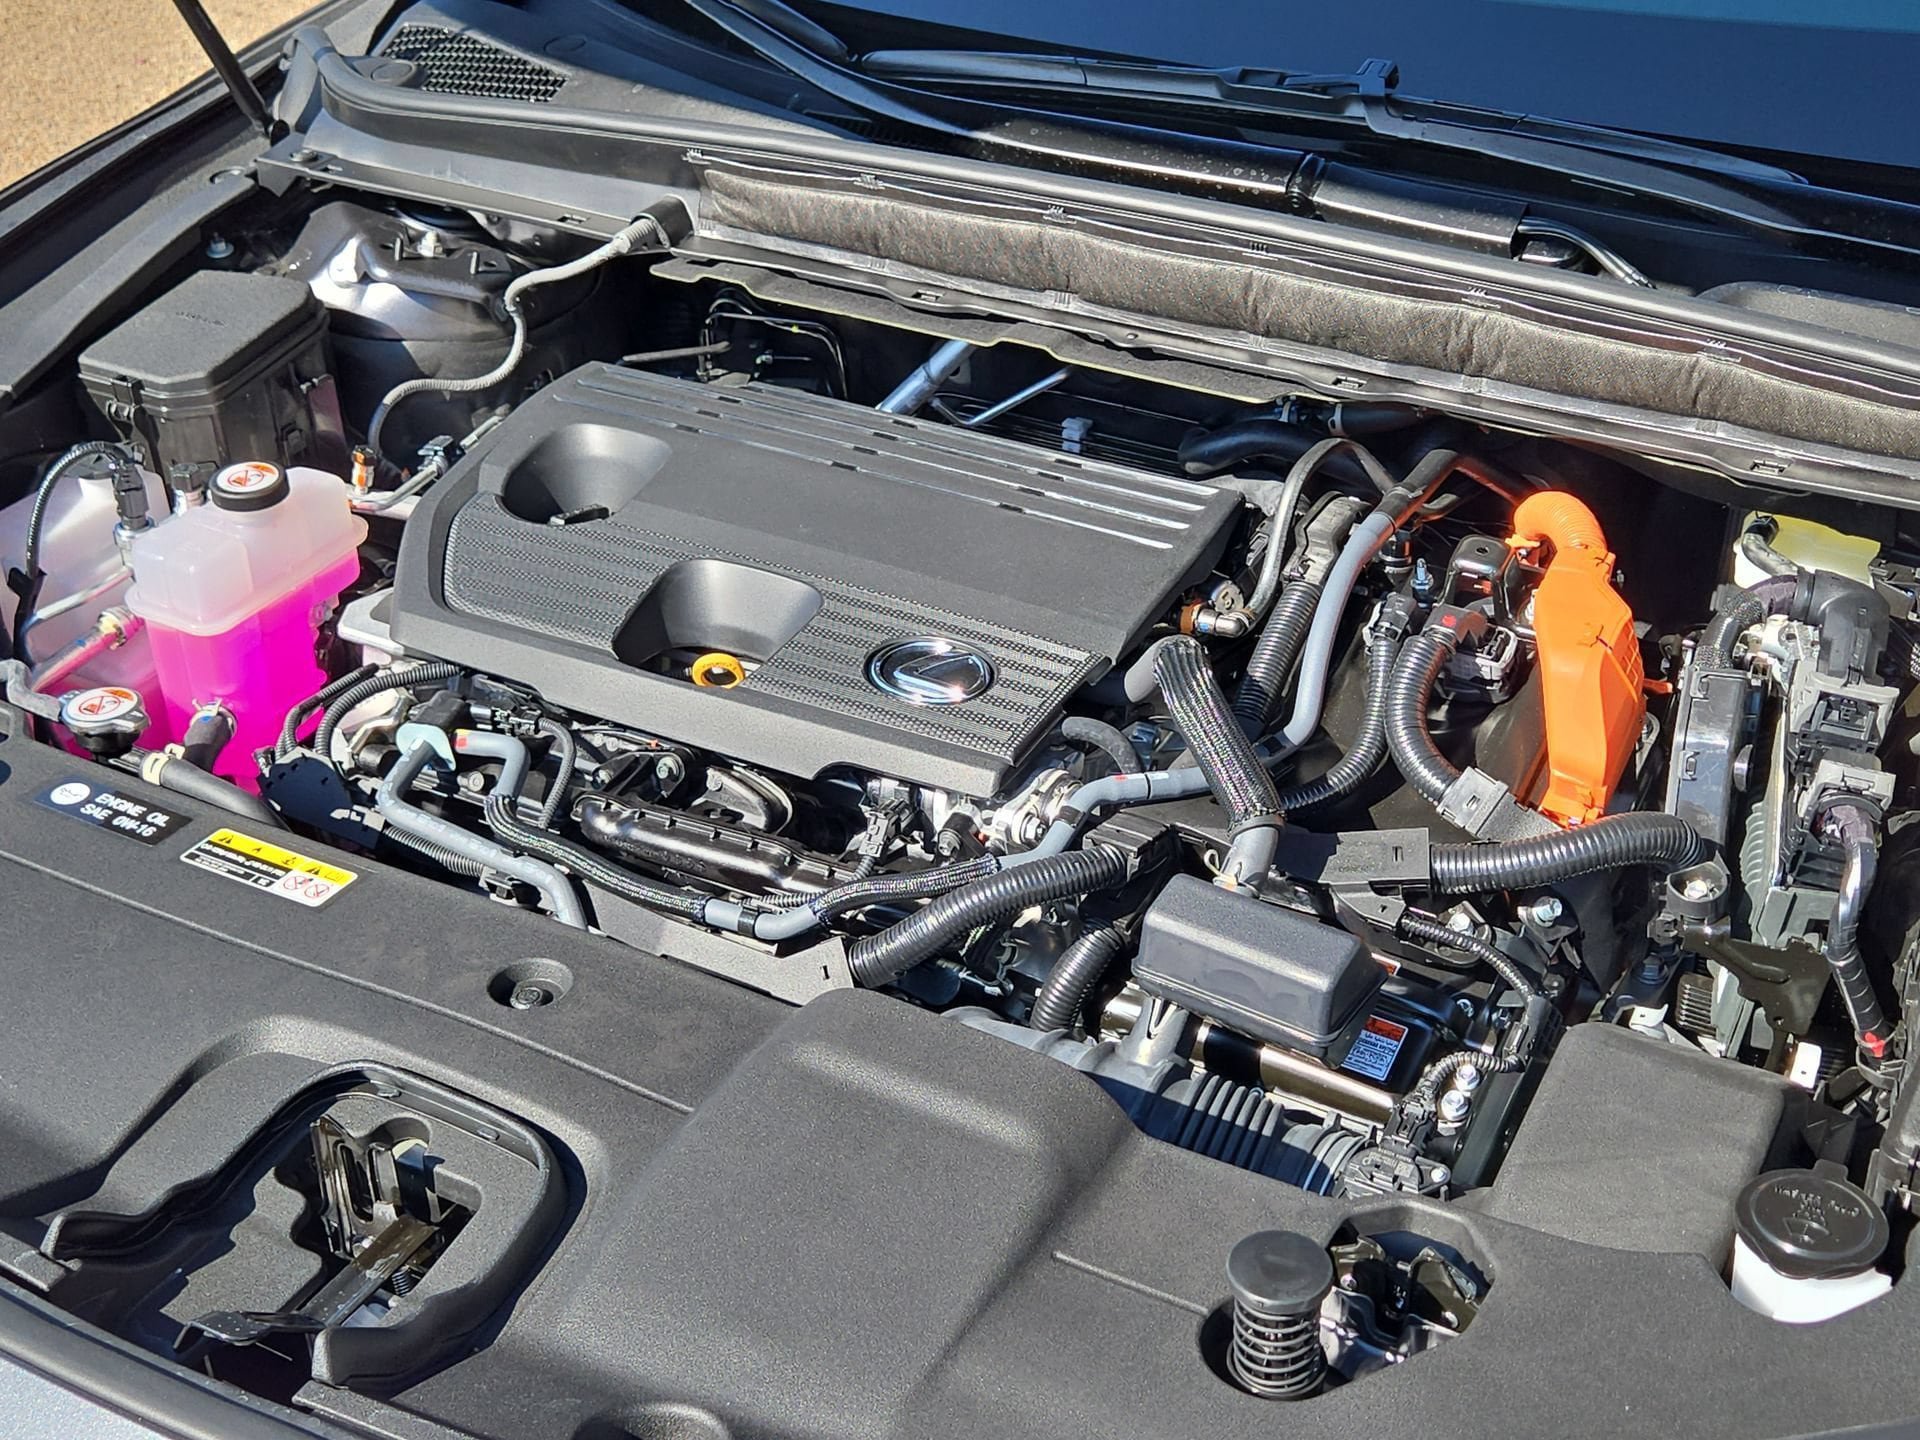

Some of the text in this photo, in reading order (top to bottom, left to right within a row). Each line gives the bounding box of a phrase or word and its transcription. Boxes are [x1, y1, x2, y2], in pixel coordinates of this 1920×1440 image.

[80, 803, 156, 837] SAE 0W-16
[95, 793, 170, 827] ENGINE OIL
